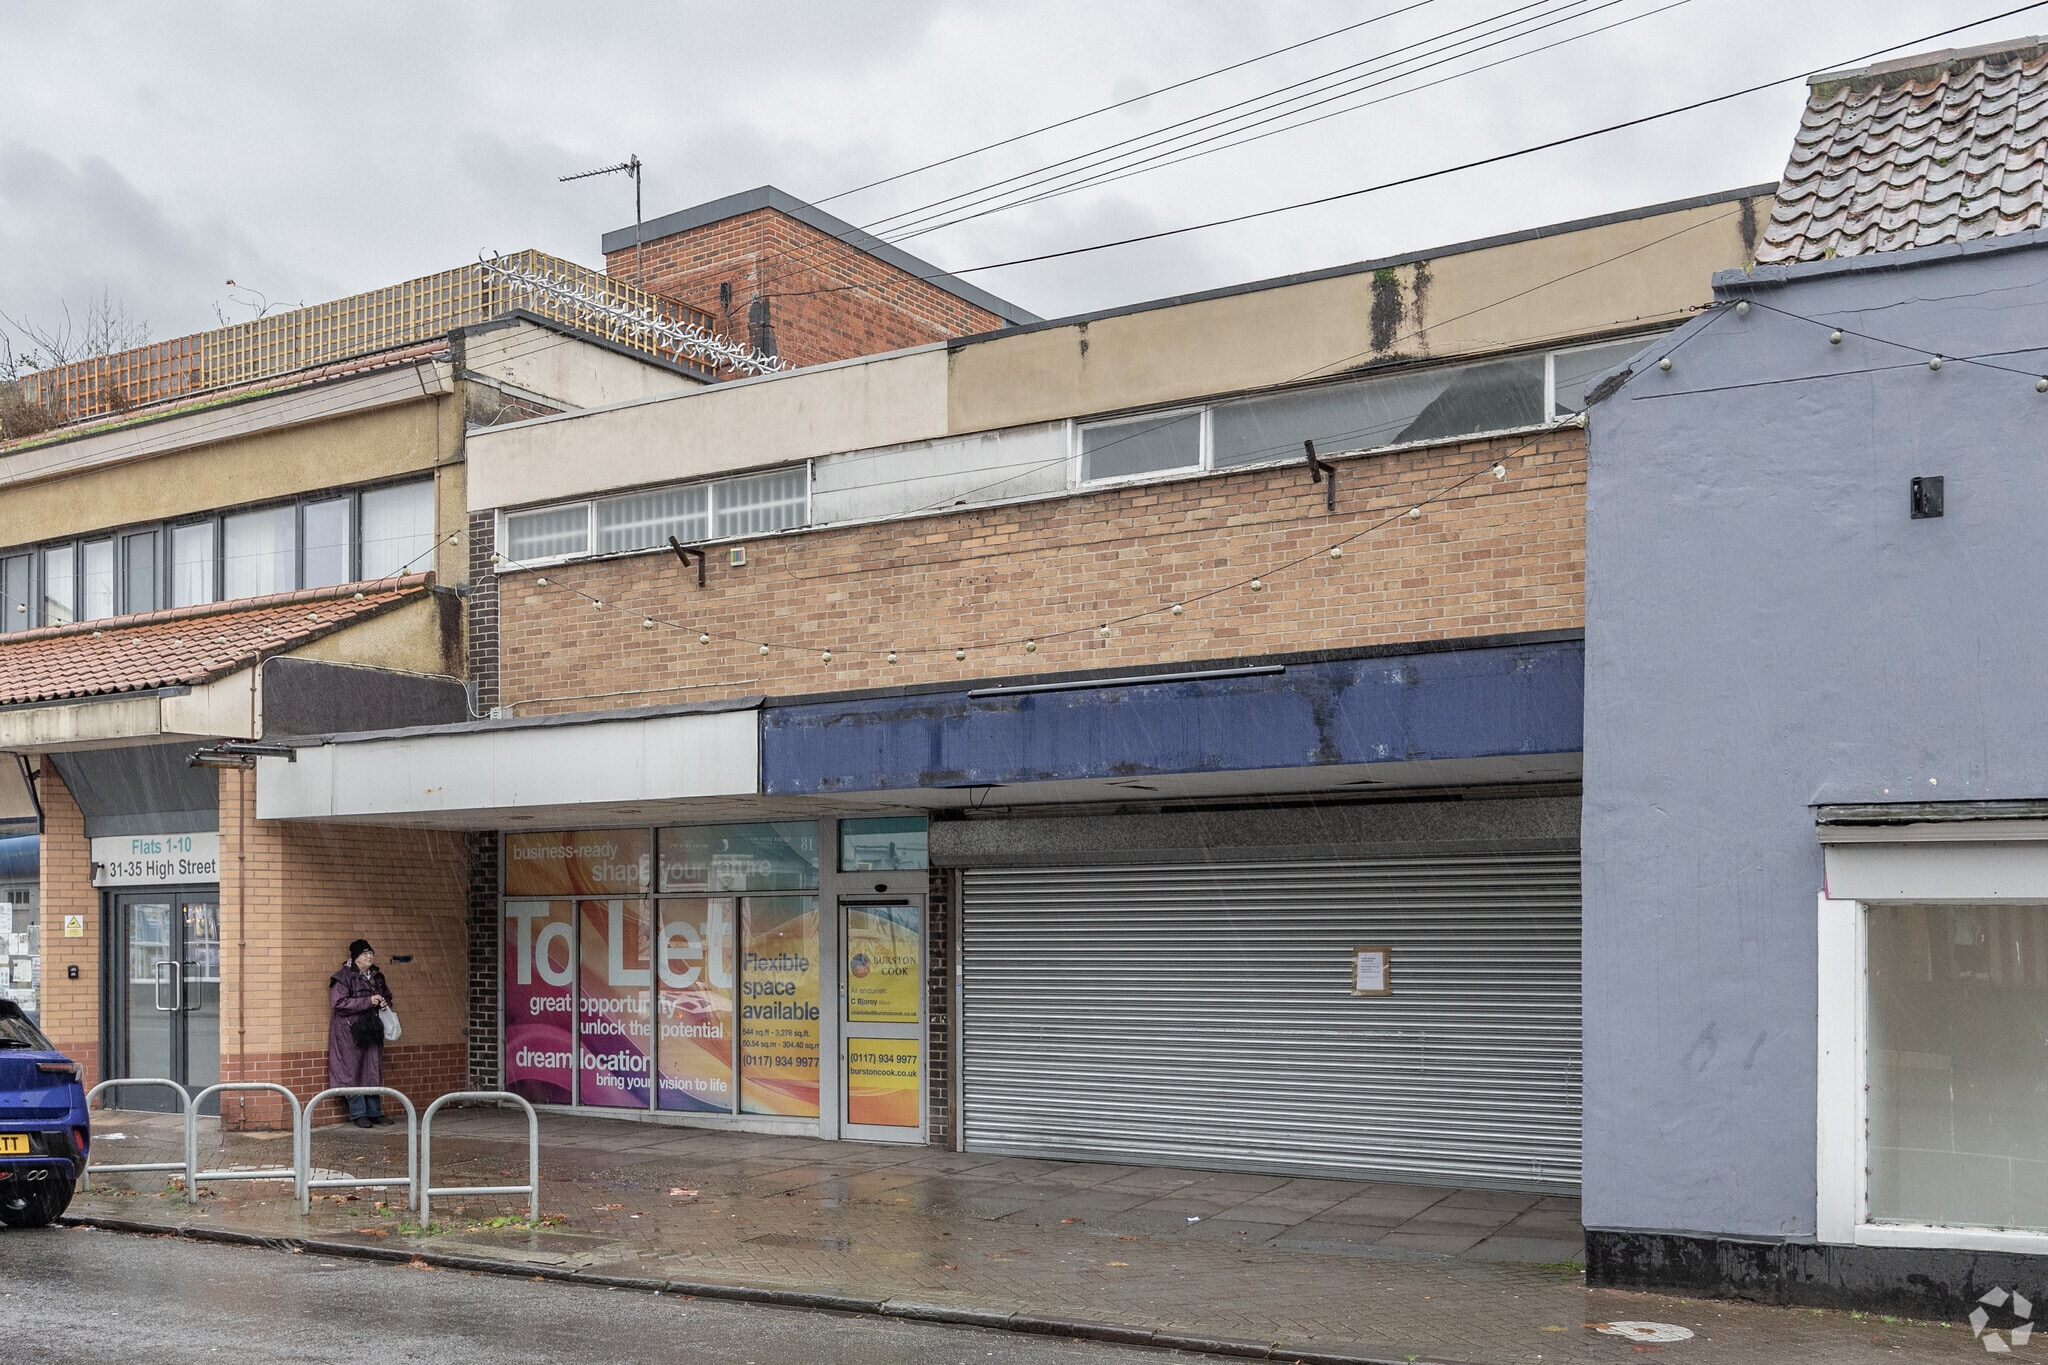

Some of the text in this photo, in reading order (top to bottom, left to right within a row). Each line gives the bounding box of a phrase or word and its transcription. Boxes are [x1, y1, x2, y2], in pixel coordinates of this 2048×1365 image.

[132, 837, 192, 855] Flats 1-10
[513, 841, 618, 861] business-ready
[110, 858, 216, 880] 31-35 High Street
[592, 859, 650, 886] shape
[506, 899, 733, 989] To Let
[743, 952, 810, 972] Flexible
[873, 956, 917, 965] BURSTON
[881, 967, 909, 976] COOK
[743, 981, 796, 999] space
[530, 994, 572, 1016] great
[743, 1001, 820, 1021] available
[580, 1018, 723, 1040] unlock the potential
[742, 1039, 760, 1047] 50.54
[515, 1046, 573, 1069] dream
[743, 1054, 820, 1068] (0117) 934 9977
[850, 1053, 918, 1064] (0117) 934 9977
[596, 1072, 624, 1089] bring
[658, 1076, 693, 1091] vision
[695, 1078, 707, 1090] to
[709, 1077, 728, 1092] life
[850, 1067, 918, 1077] burstoncook.co.uk
